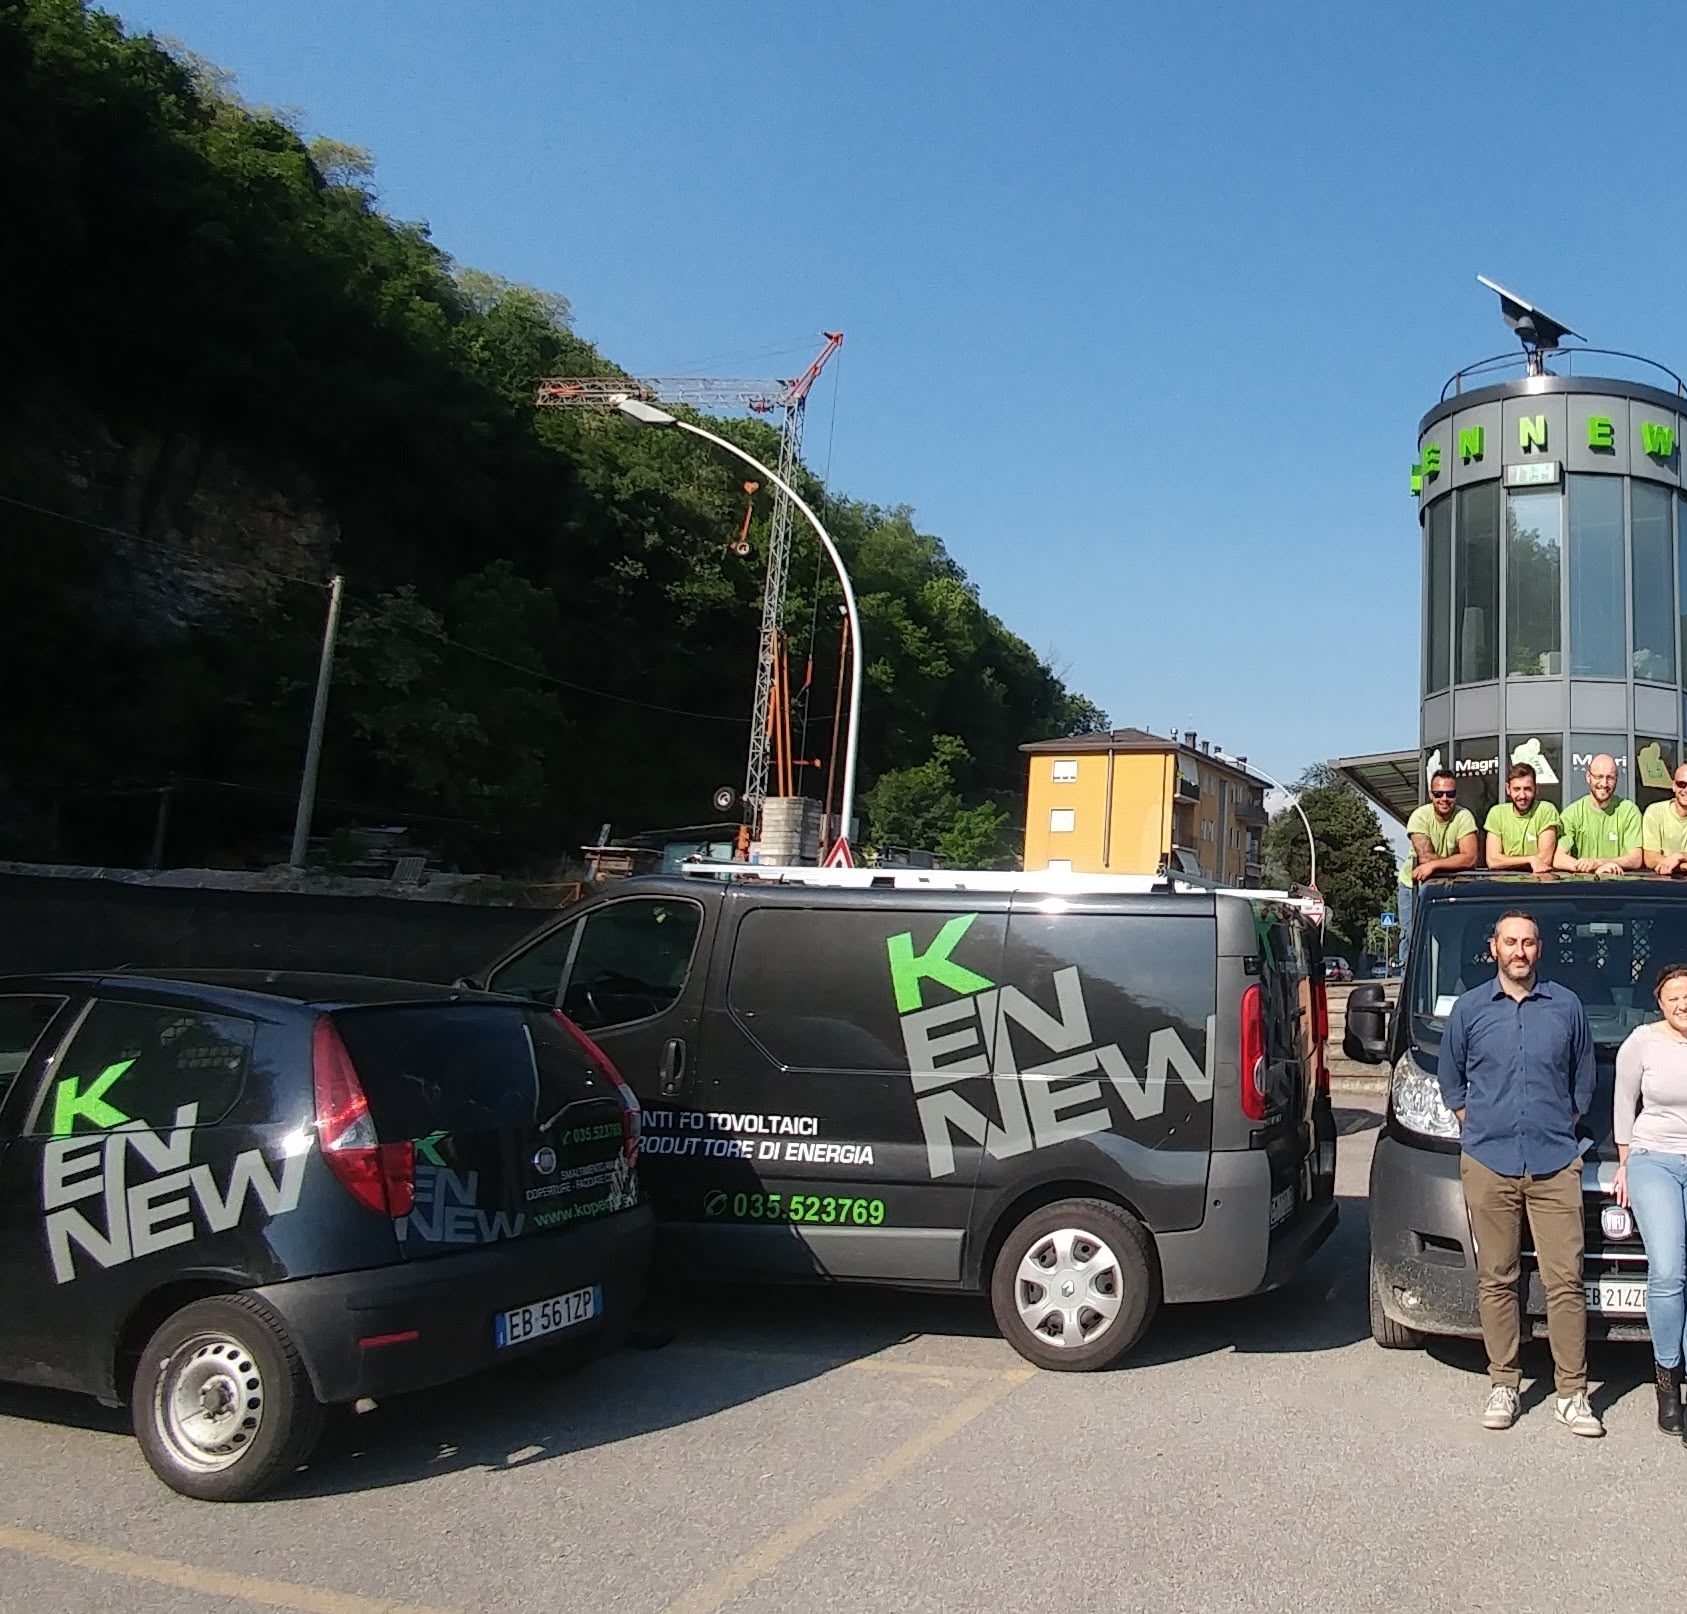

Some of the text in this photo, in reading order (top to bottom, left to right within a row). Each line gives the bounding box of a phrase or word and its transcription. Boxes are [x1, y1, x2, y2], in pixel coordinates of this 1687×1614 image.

[1455, 756, 1499, 773] Magri
[1572, 753, 1627, 767] Mri
[887, 913, 994, 1012] K
[901, 966, 1092, 1093] EN
[52, 1058, 136, 1139] K
[916, 1014, 1215, 1179] NEW
[44, 1100, 199, 1210] EN
[759, 1142, 780, 1161] DI
[785, 1143, 875, 1165] ENERGIA
[44, 1133, 318, 1285] NEW
[733, 1193, 885, 1224] 035.523769
[509, 1308, 533, 1341] EB
[541, 1290, 592, 1330] 561ZP
[1584, 1287, 1600, 1306] EB
